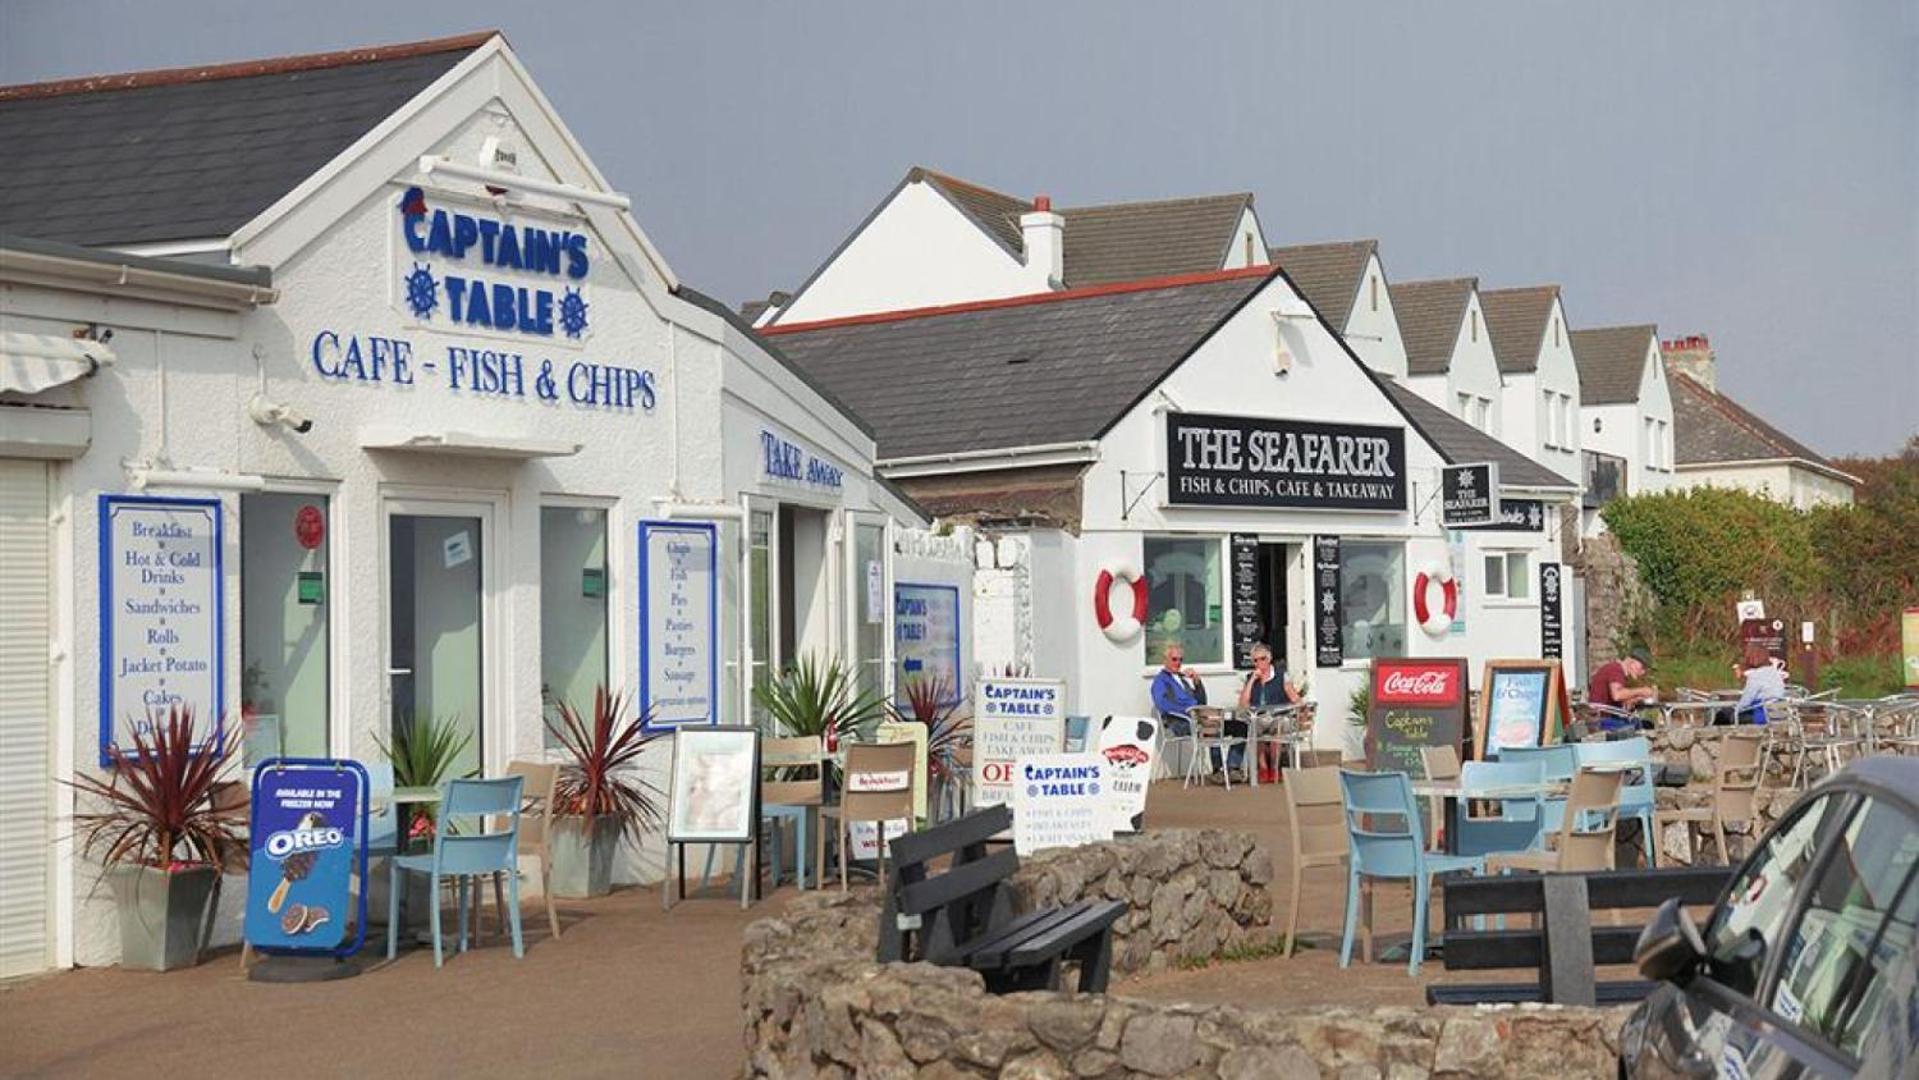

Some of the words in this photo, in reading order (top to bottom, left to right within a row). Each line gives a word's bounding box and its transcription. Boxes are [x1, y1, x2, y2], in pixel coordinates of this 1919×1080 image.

[402, 206, 589, 279] CAPTAIN'S
[445, 275, 553, 335] TABLE
[313, 329, 413, 385] CAFE
[447, 346, 524, 396] FISH
[535, 359, 558, 400] &
[567, 361, 656, 409] CHIPS
[761, 429, 802, 480] TAKE
[806, 456, 844, 487] AWAY
[1178, 426, 1243, 471] THE
[1248, 429, 1395, 477] SEAFARER
[1180, 475, 1211, 494] FISH
[1214, 477, 1225, 494] &
[1228, 478, 1274, 498] CHIPS,
[1276, 479, 1310, 497] CAFE
[1313, 480, 1324, 497] &
[1326, 481, 1395, 500] TAKEAWAY
[132, 520, 193, 538] Breakfast
[125, 551, 150, 566] Hot
[154, 551, 167, 566] &
[170, 551, 201, 567] Cold
[141, 569, 185, 585] Drinks
[125, 599, 201, 615] Sandwiches
[147, 628, 180, 645] Rolls
[119, 657, 162, 678] Jacket
[166, 657, 208, 673] Potato
[143, 689, 183, 706] Cakes
[985, 684, 1055, 700] CAPTAIN'S
[1000, 703, 1041, 715] TABLE
[1025, 765, 1100, 780] CAPTAIN'S
[1042, 783, 1085, 796] TABLE
[267, 829, 343, 856] OREO
